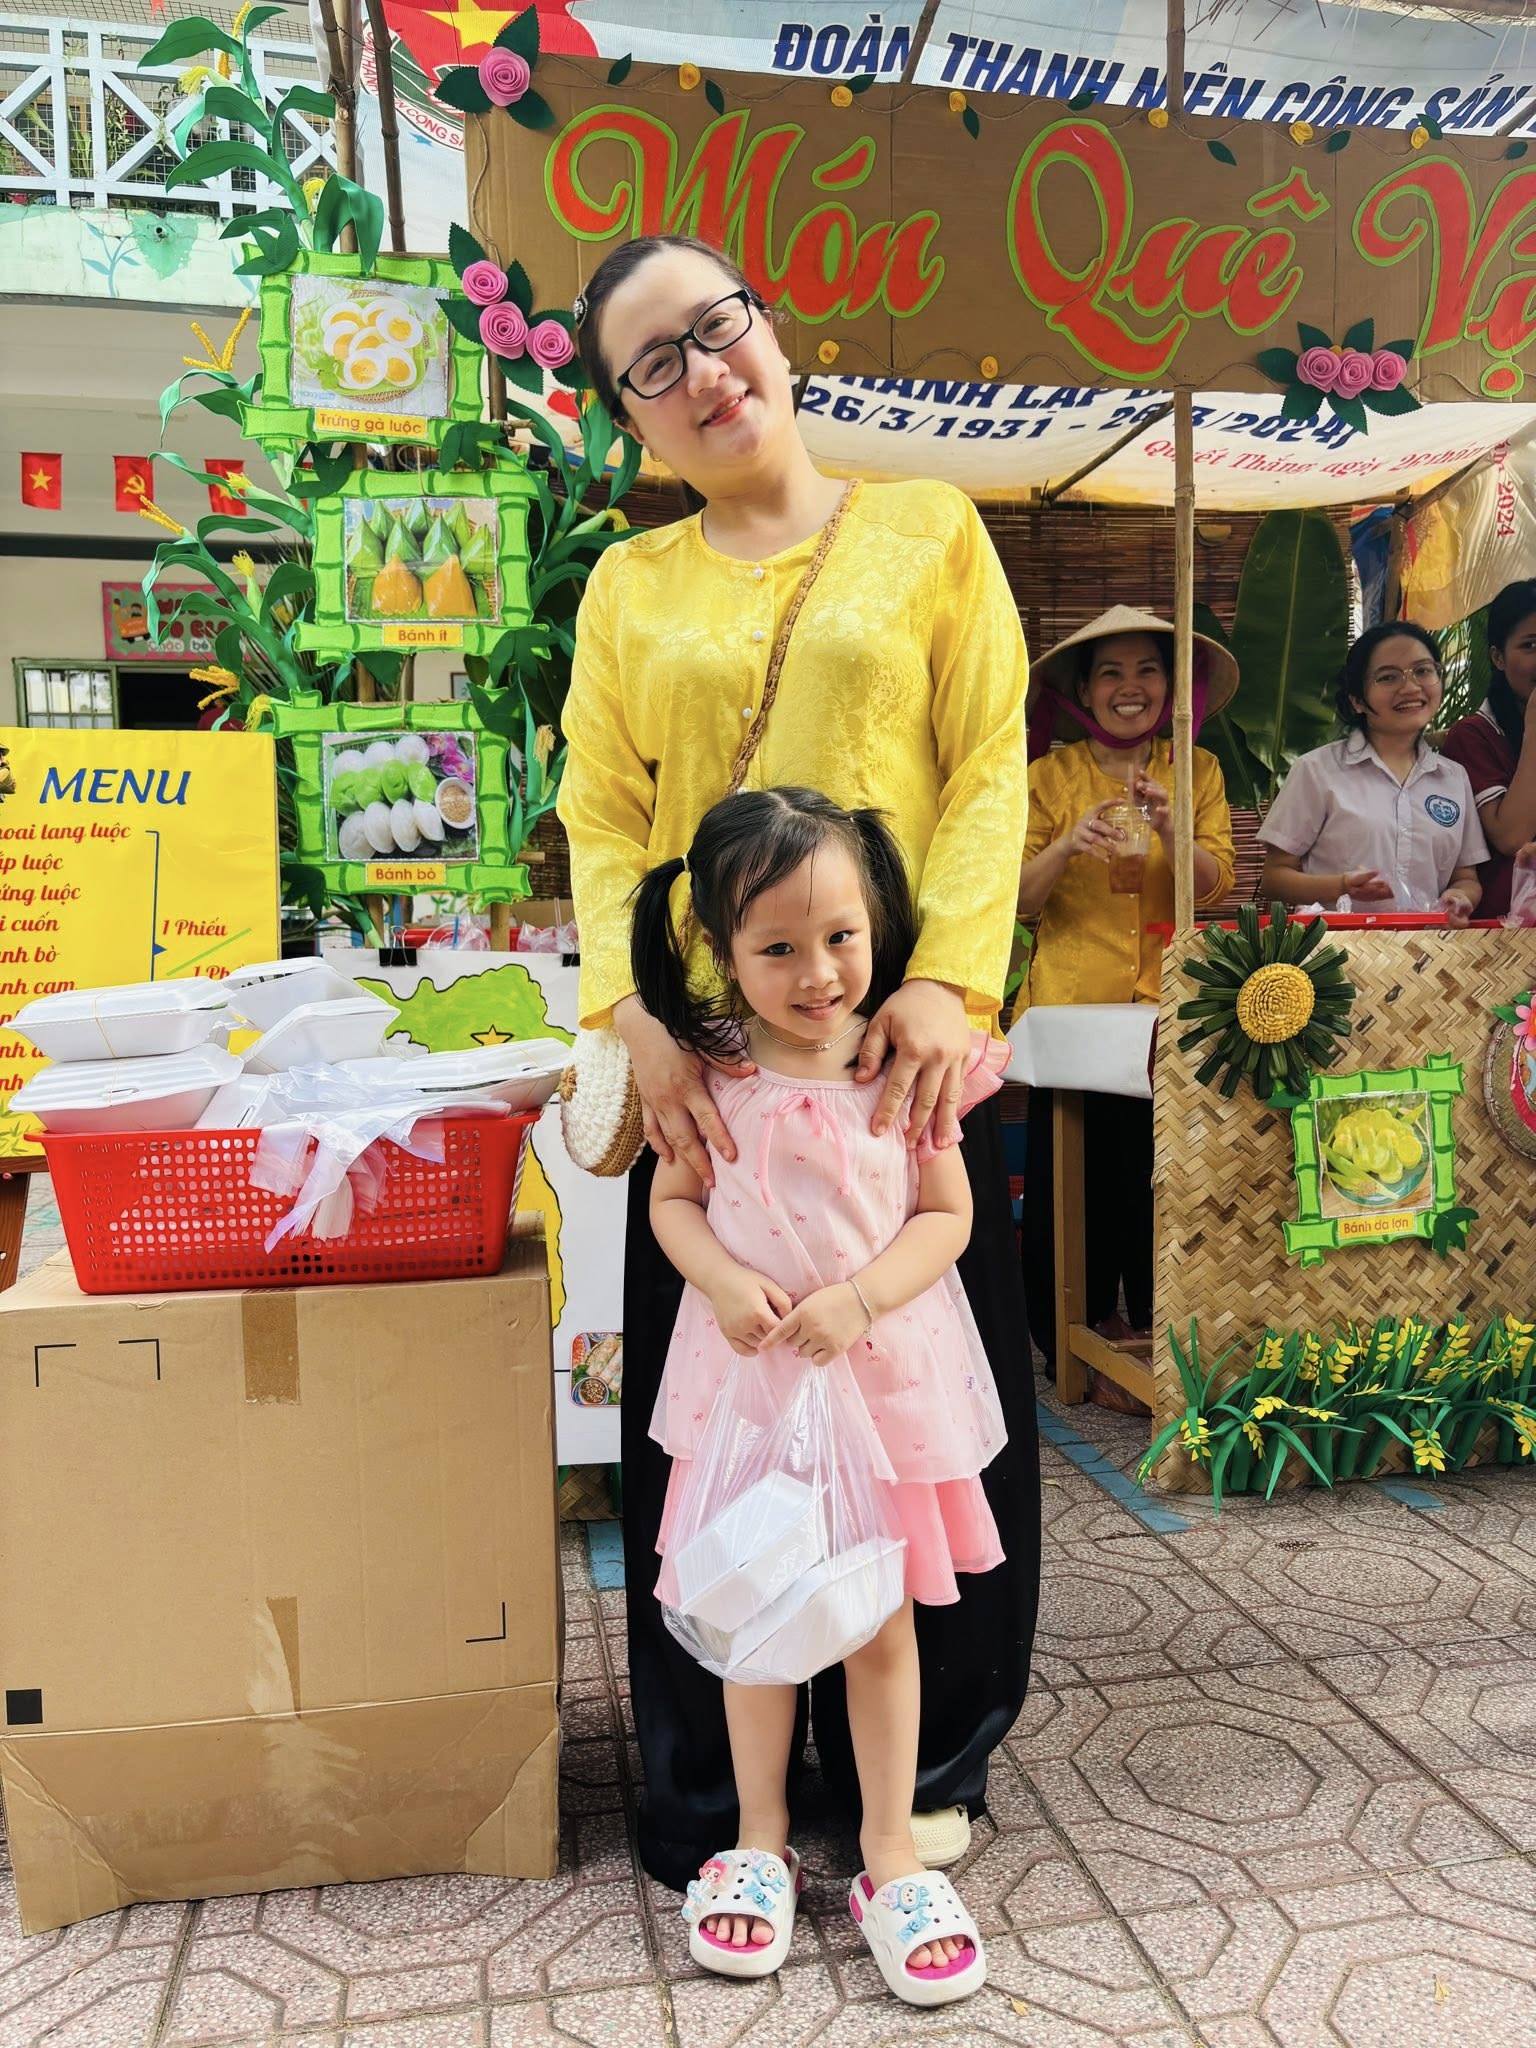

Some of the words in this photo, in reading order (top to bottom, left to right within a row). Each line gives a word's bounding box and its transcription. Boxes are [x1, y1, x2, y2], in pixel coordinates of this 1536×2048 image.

[940, 32, 1125, 104] THANH
[544, 103, 945, 325] Món
[1006, 118, 1331, 381] Quê
[320, 412, 360, 431] Trứng
[364, 416, 385, 433] gà
[390, 419, 423, 434] luộc
[398, 629, 435, 642] Bánh
[39, 766, 192, 806] MENU
[41, 823, 85, 844] lang
[90, 822, 131, 843] luộc
[22, 853, 64, 876] luộc
[376, 868, 412, 880] Bánh
[417, 868, 436, 880] bò
[40, 883, 81, 906] luộc
[11, 911, 60, 932] cuốn
[175, 917, 227, 937] Phiếu
[34, 945, 60, 963] bò
[34, 980, 77, 995] cam
[1344, 1221, 1371, 1234] Bánh
